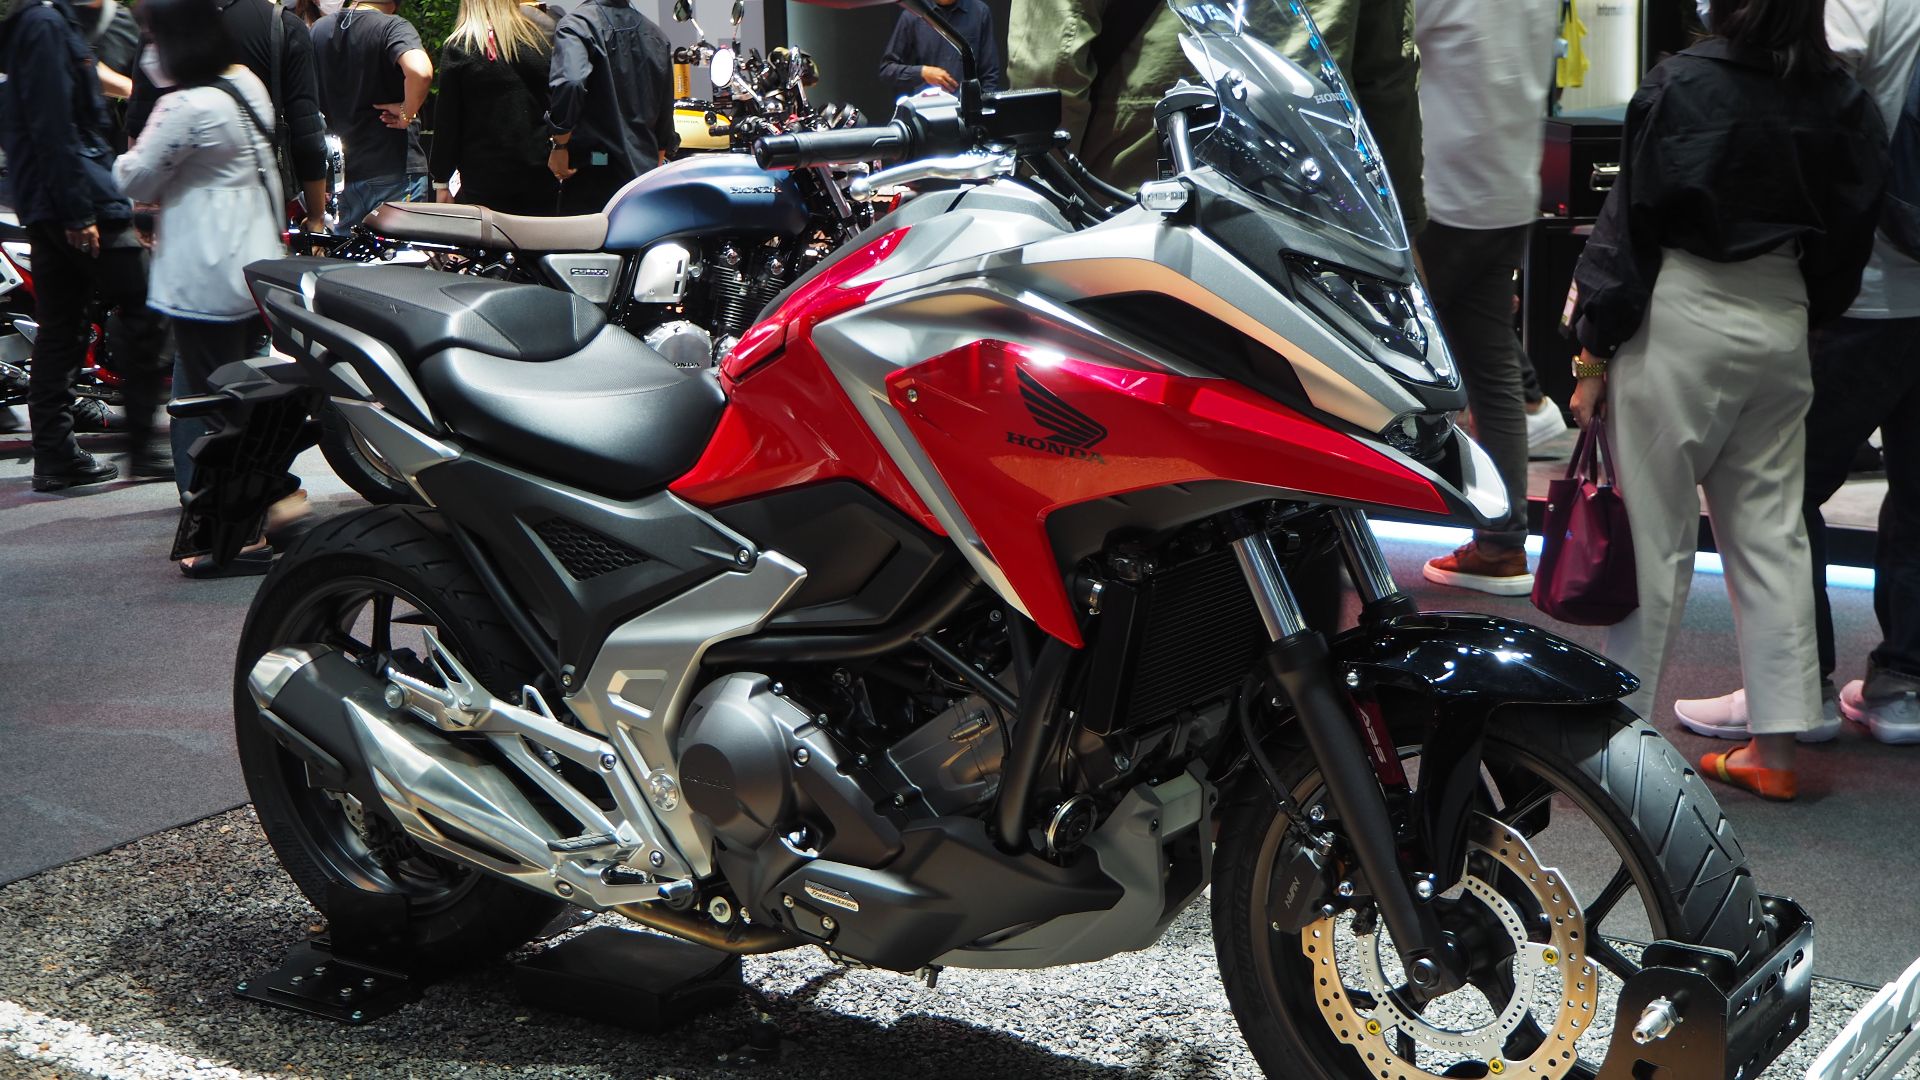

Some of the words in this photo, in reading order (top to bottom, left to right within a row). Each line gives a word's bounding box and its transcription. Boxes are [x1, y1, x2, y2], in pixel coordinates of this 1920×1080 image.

[1313, 91, 1348, 104] HOND
[1006, 431, 1105, 465] HONDA
[1359, 707, 1387, 763] ABS
[811, 890, 857, 908] Transmission
